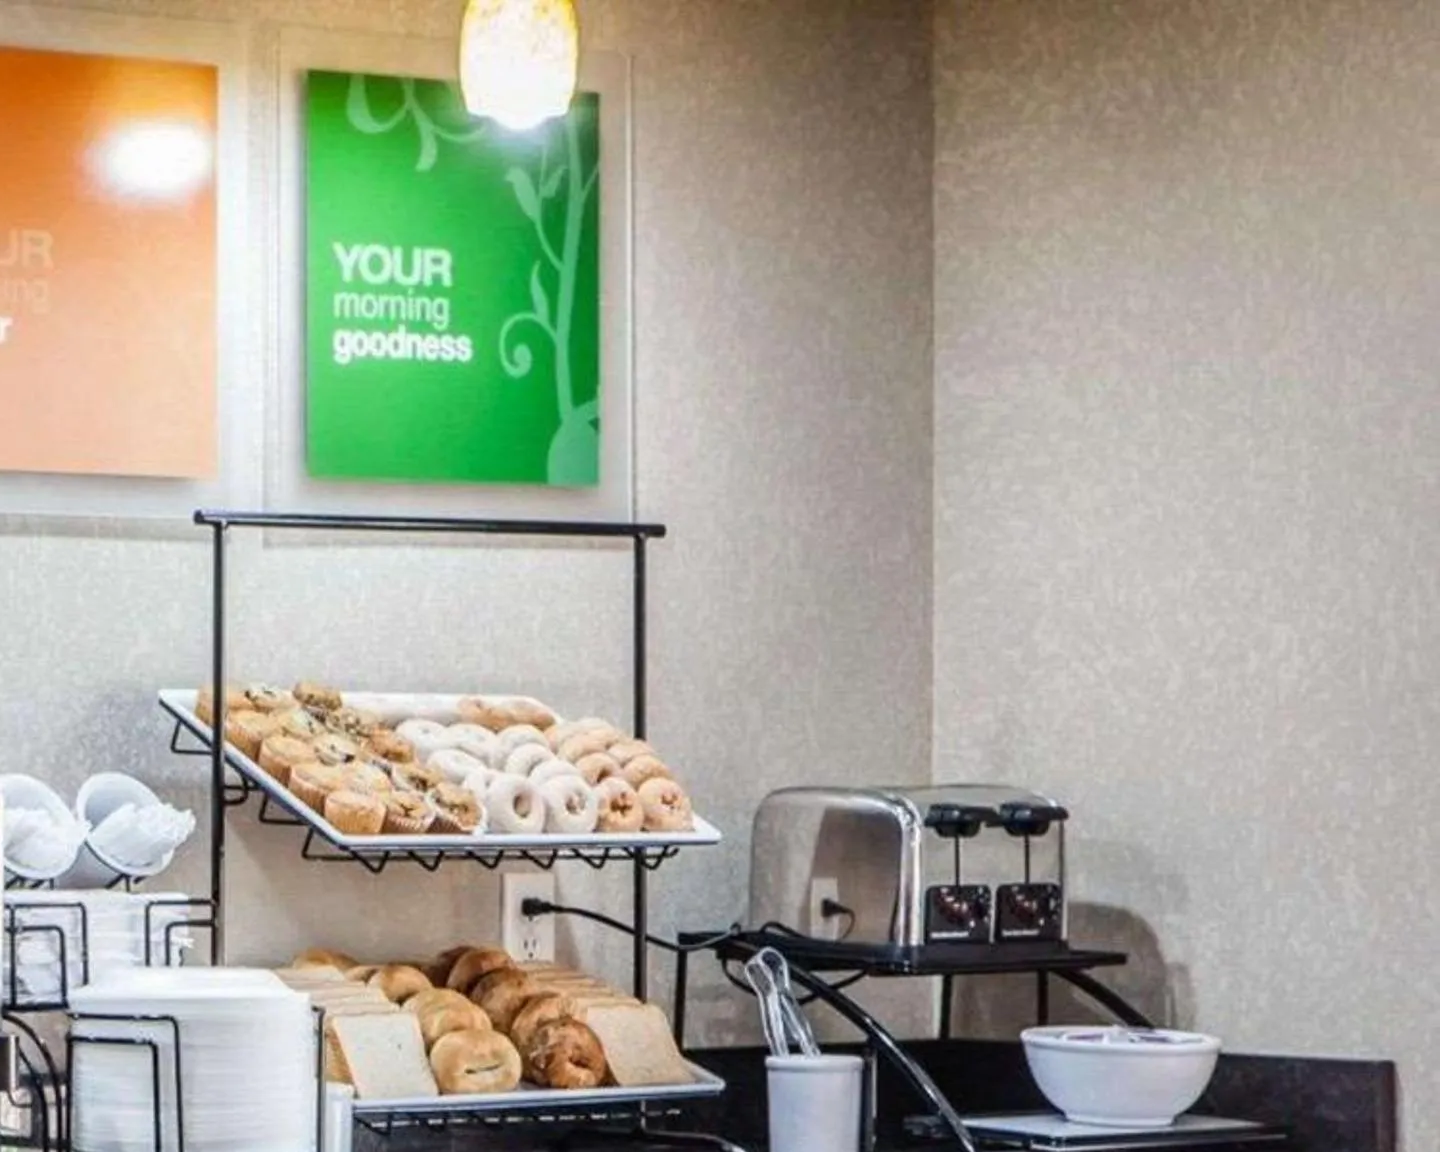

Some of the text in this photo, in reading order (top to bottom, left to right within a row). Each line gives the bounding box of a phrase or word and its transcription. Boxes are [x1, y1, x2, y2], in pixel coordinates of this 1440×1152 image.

[333, 241, 453, 287] YOUR
[334, 286, 450, 331] morning
[333, 324, 473, 365] goodness
